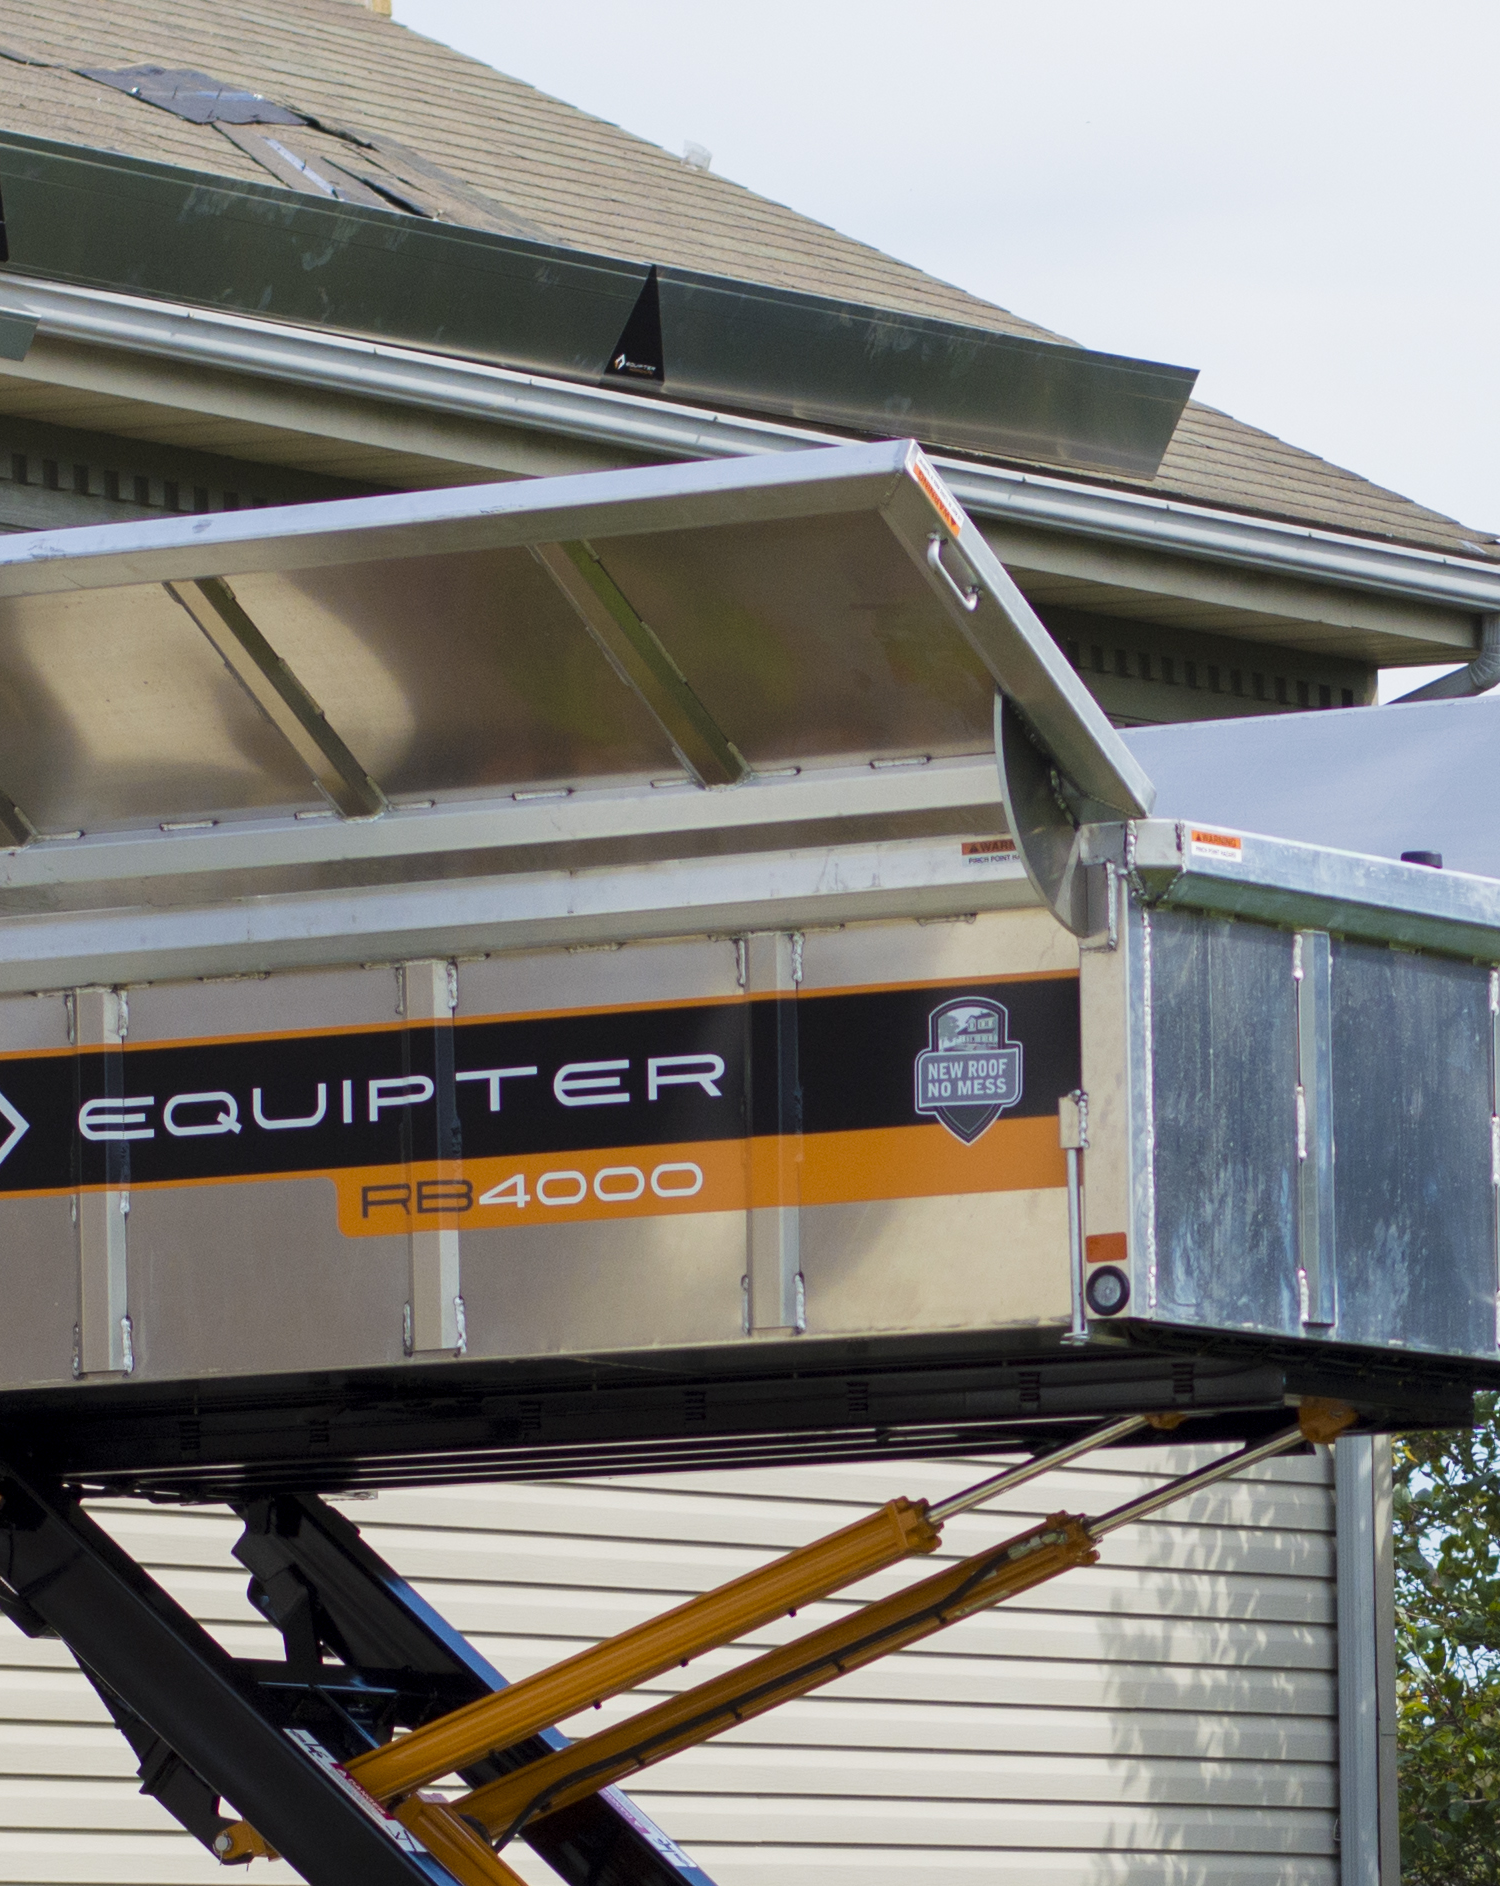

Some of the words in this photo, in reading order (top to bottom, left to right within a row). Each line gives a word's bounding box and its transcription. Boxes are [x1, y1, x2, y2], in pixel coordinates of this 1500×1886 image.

[927, 1061, 964, 1080] NEW
[968, 1058, 1009, 1078] ROOF
[927, 1082, 952, 1098] NO
[957, 1078, 1007, 1096] MESS
[78, 1053, 726, 1141] EQUIPTER
[361, 1161, 705, 1219] RB4000
